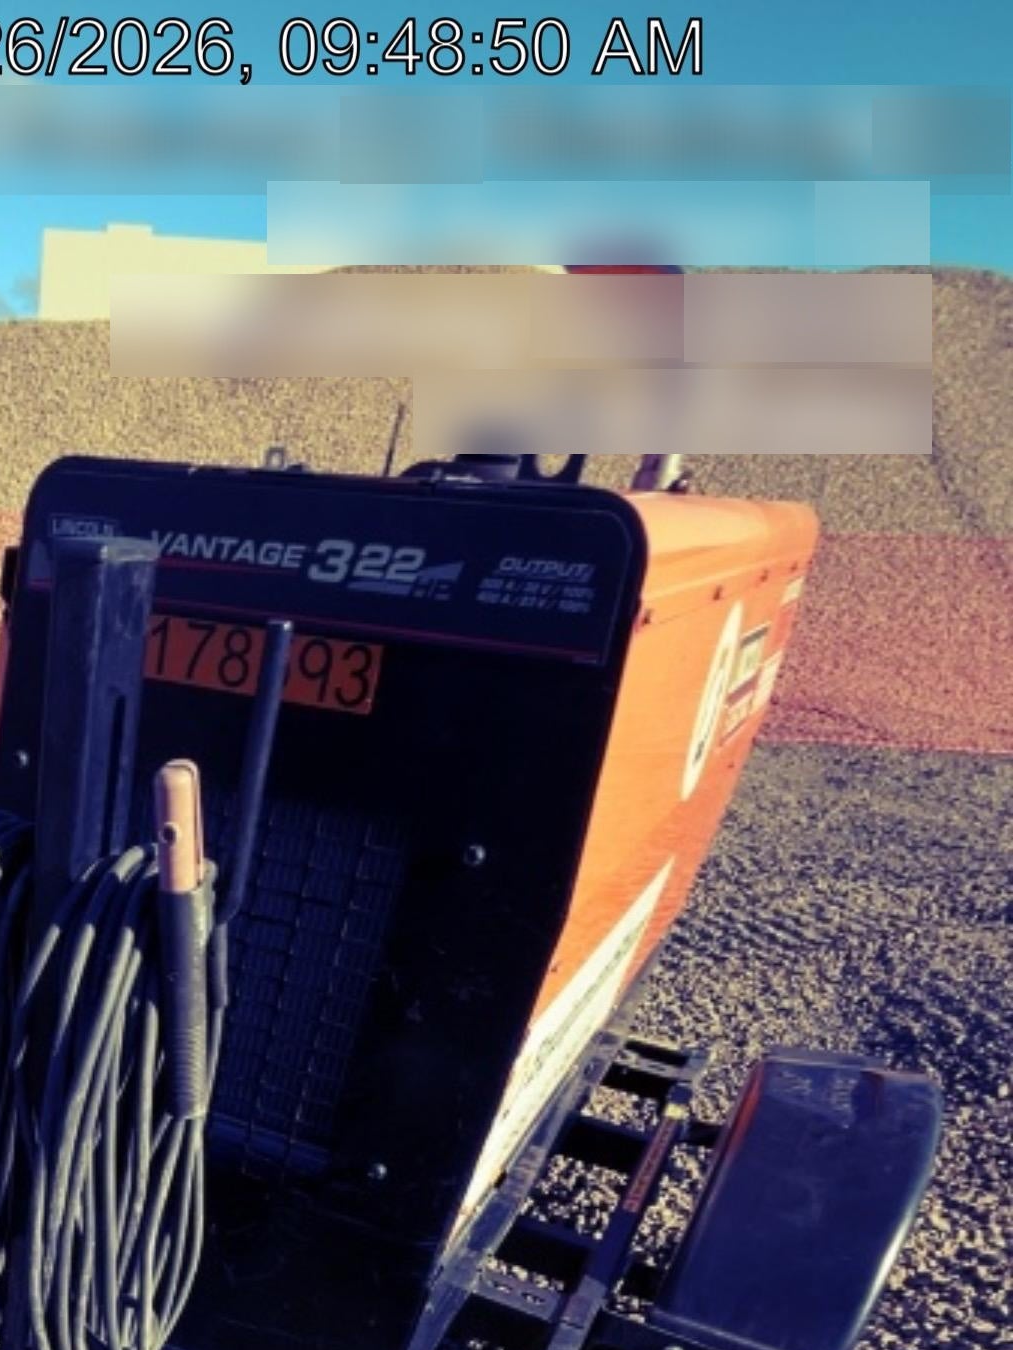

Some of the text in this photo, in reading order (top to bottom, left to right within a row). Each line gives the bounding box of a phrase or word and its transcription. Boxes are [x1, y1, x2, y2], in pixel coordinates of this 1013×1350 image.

[151, 530, 426, 583] VANTAGE 322
[150, 617, 373, 707] 17893
